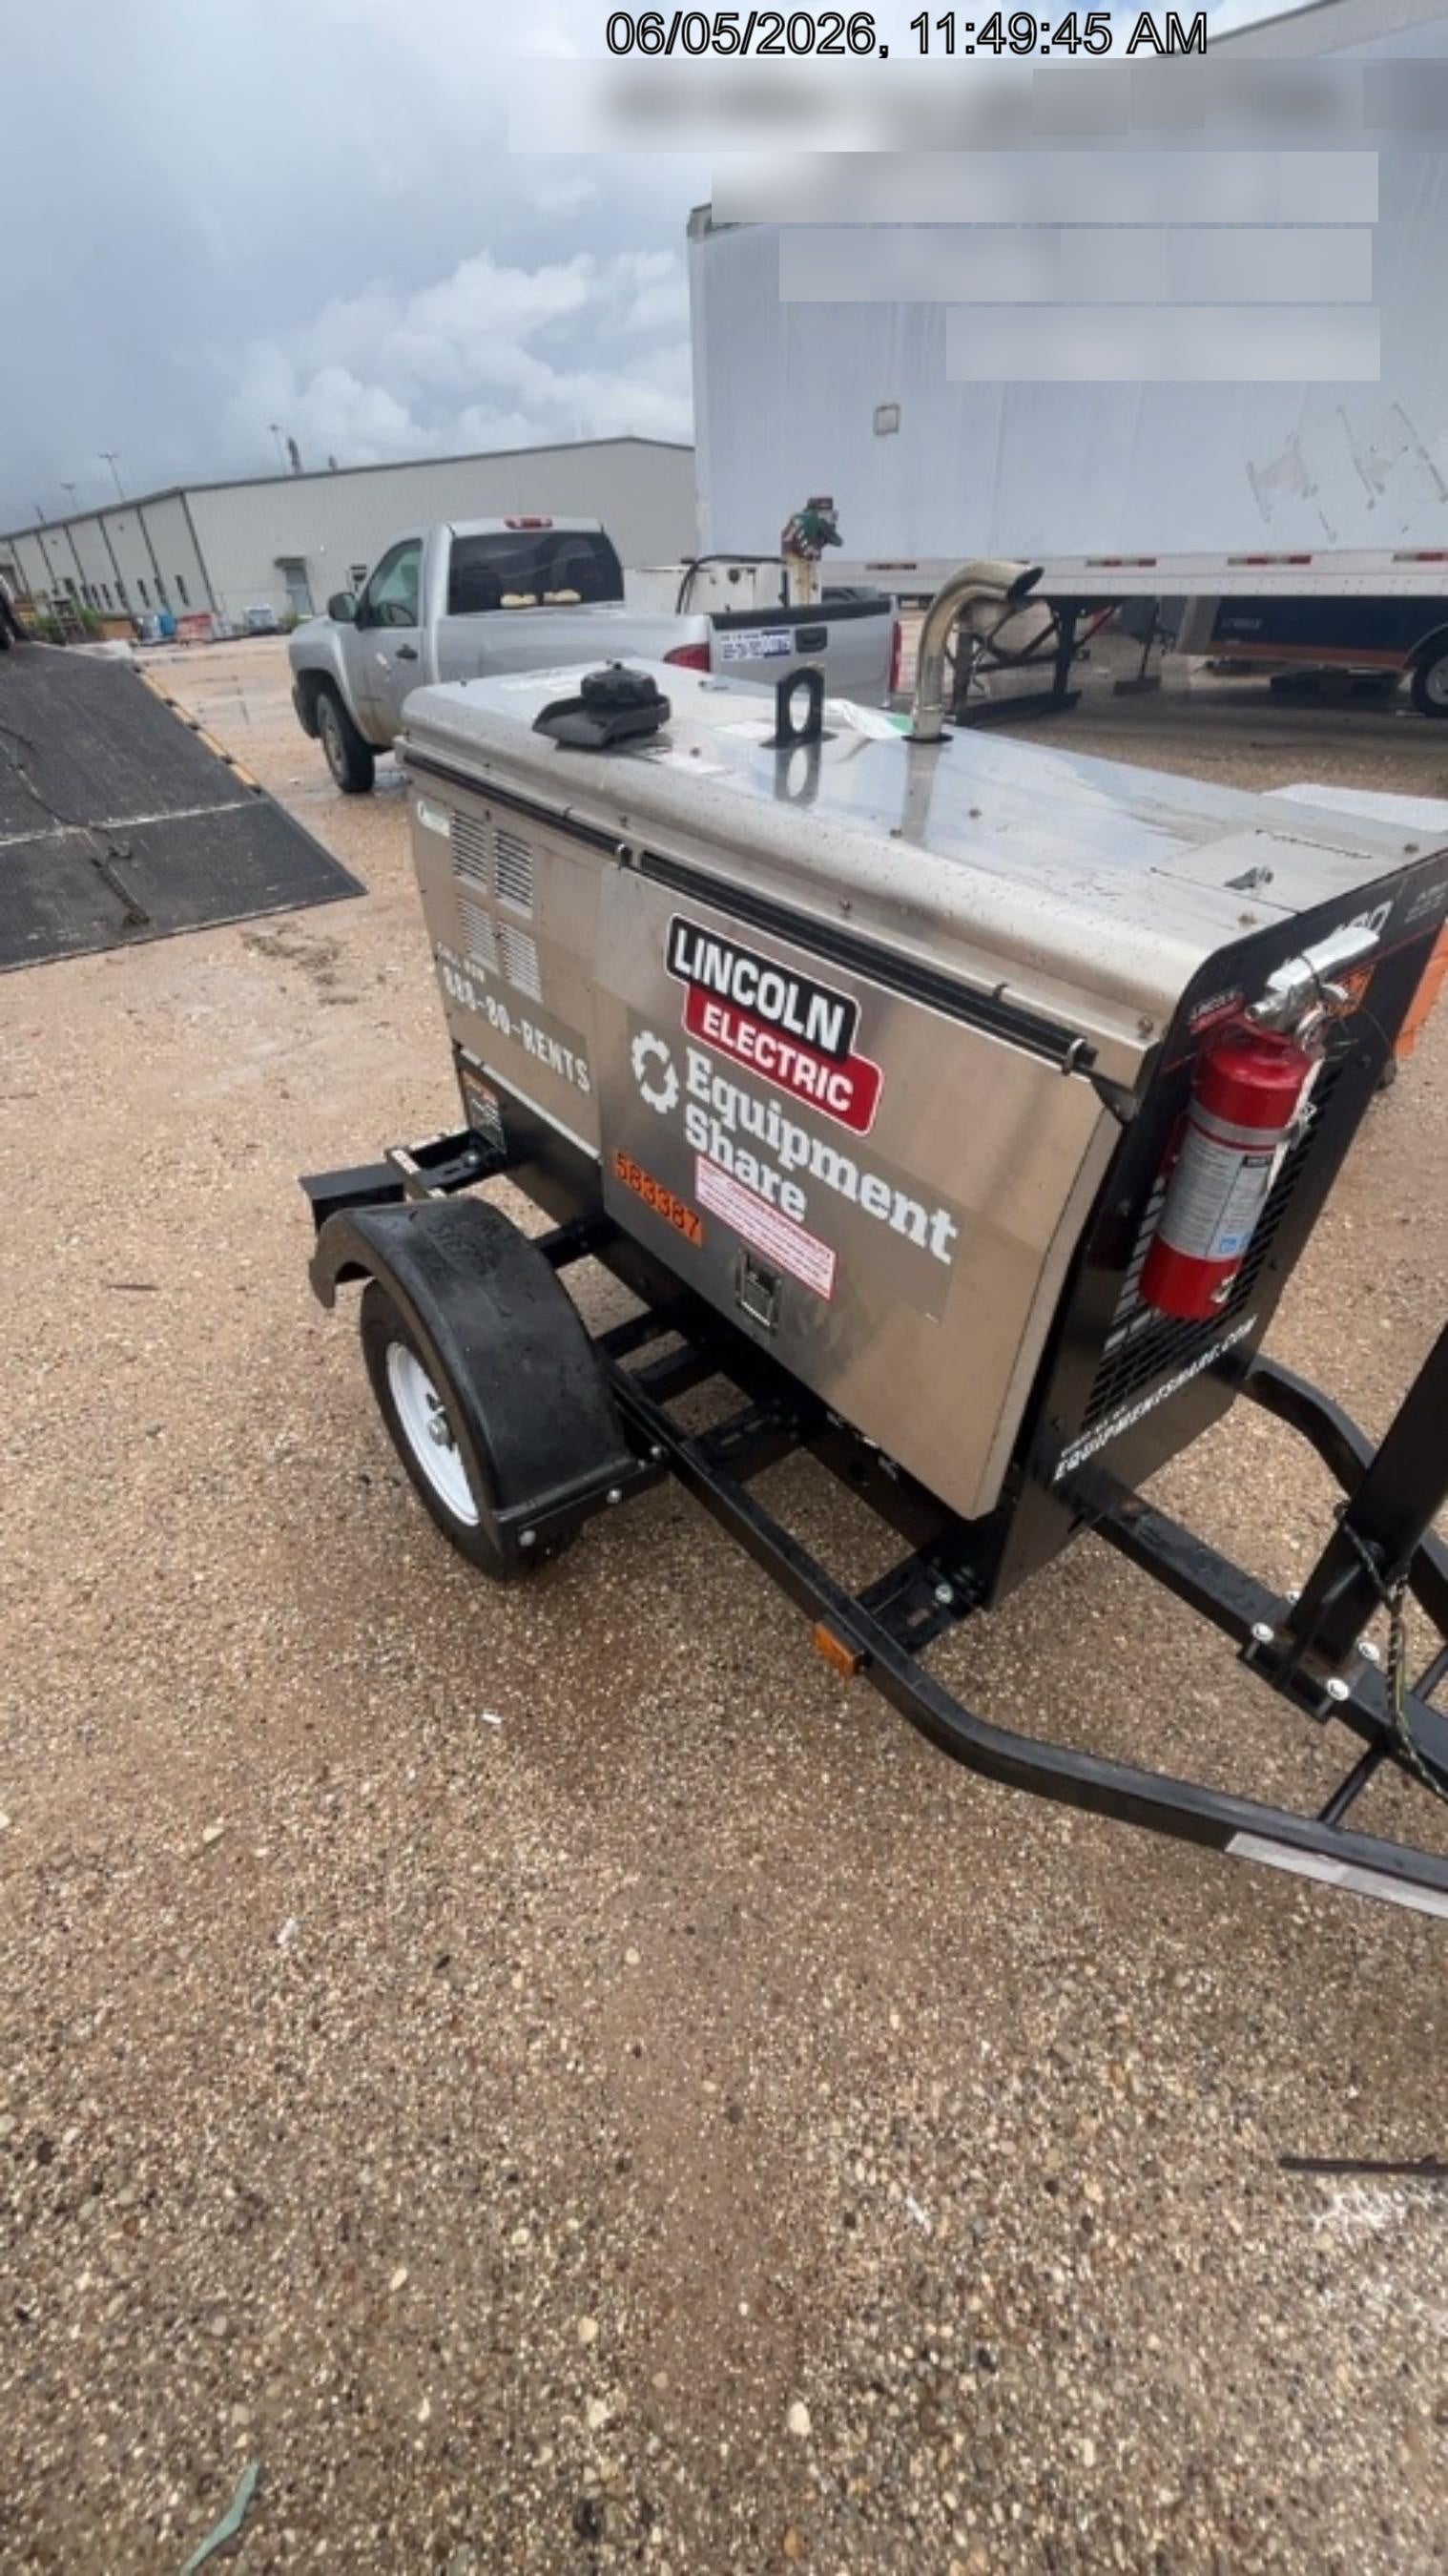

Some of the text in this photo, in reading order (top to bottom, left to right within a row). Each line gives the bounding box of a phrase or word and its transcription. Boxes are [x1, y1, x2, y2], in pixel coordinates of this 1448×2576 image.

[673, 927, 845, 1054] LINCOLN
[701, 1001, 855, 1112] ELECTRIC
[685, 1046, 959, 1266] Equipment
[685, 1103, 808, 1224] Share
